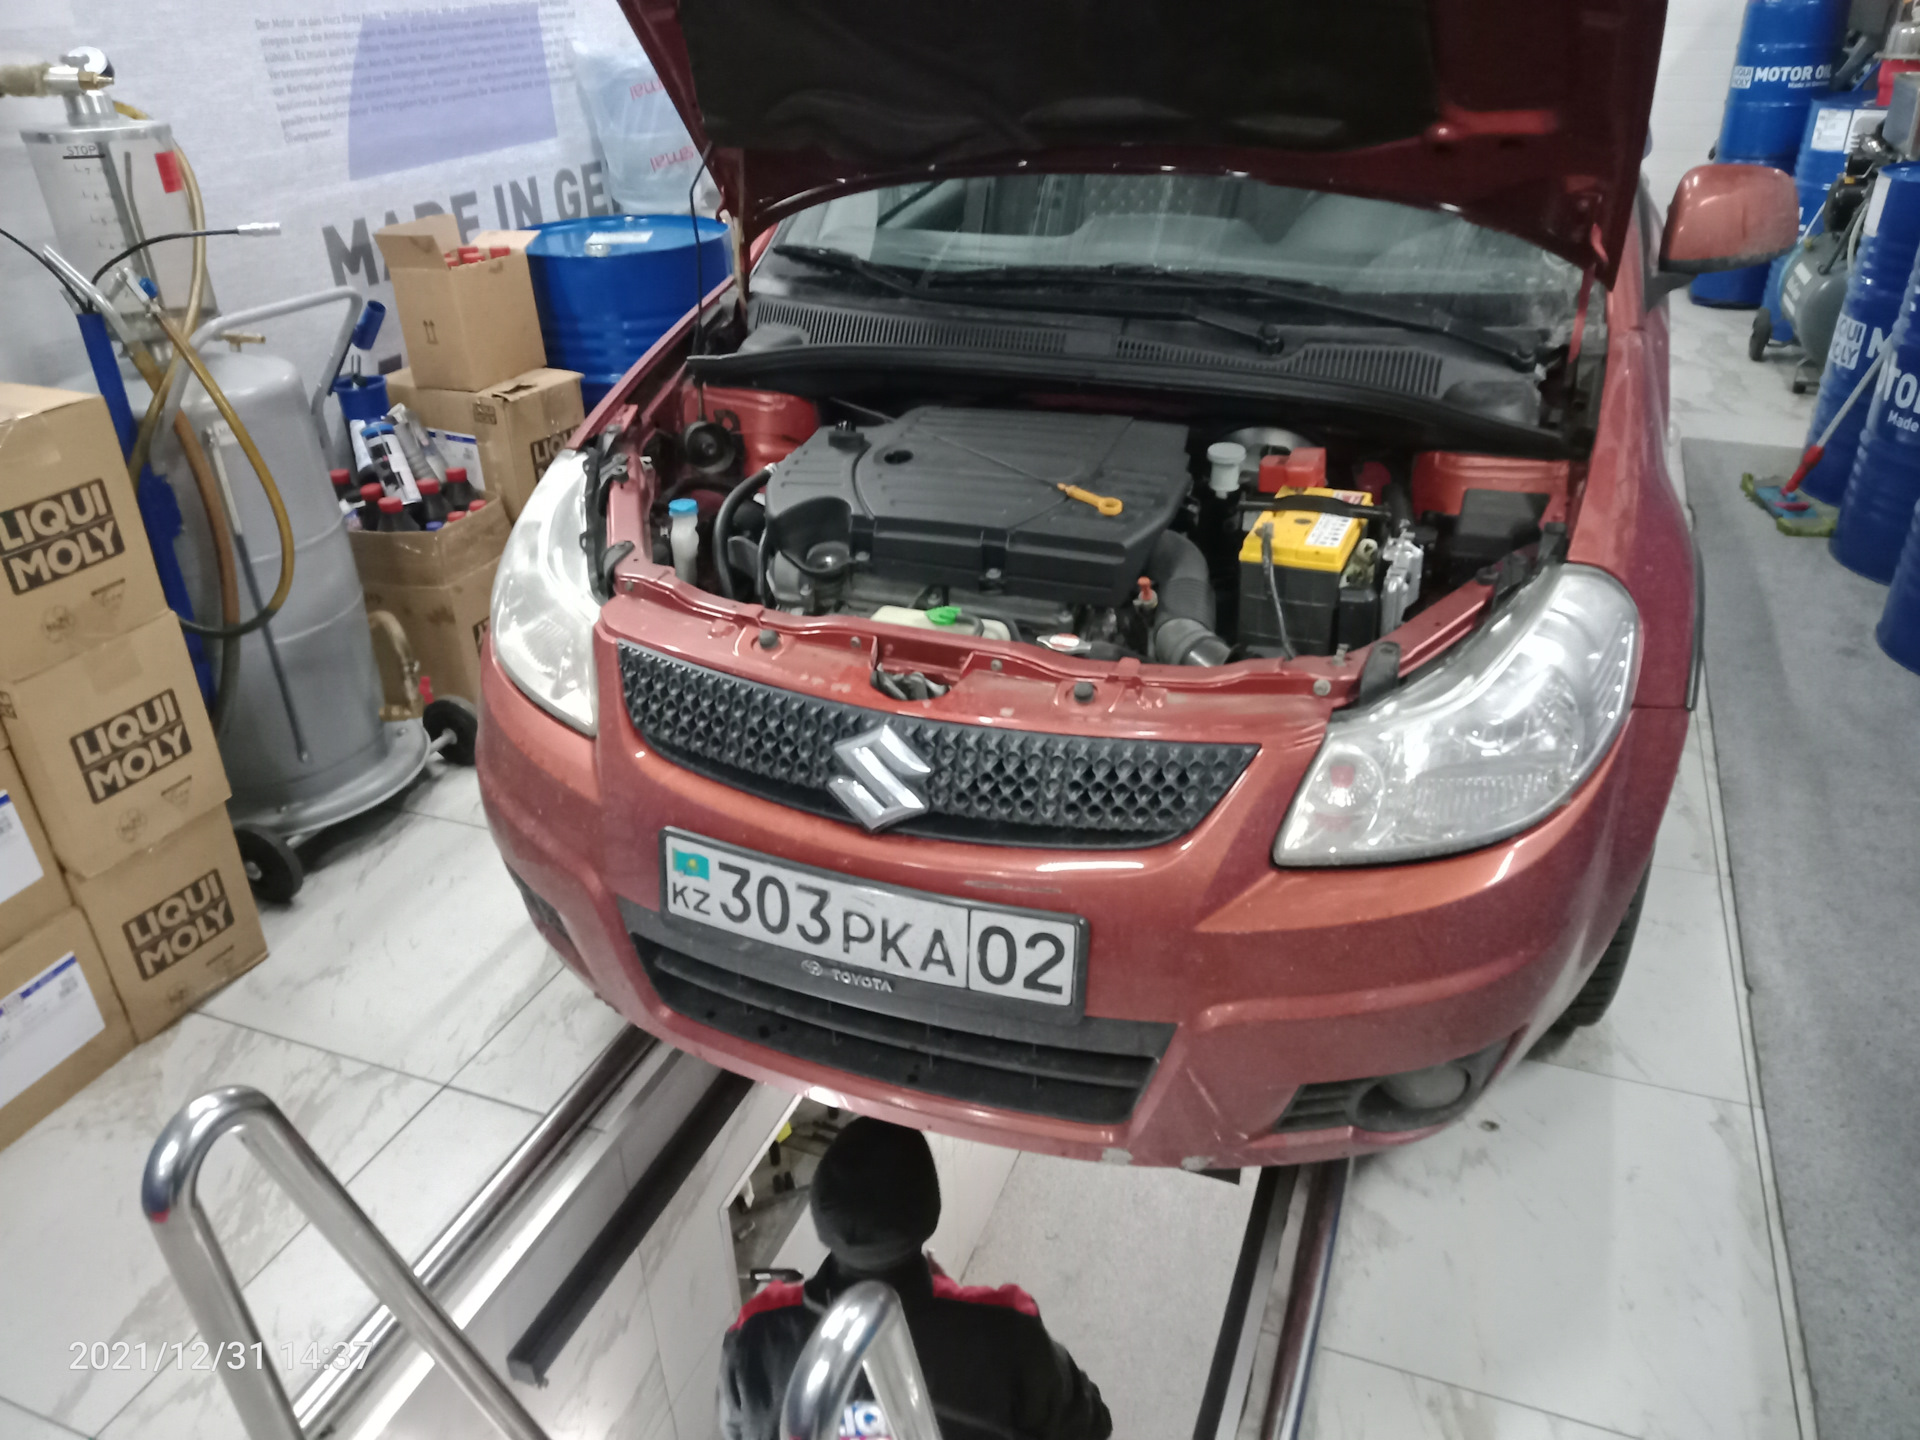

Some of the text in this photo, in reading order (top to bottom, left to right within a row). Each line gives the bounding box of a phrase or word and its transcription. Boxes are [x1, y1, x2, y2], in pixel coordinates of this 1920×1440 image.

[1754, 65, 1813, 82] MOTOR
[66, 144, 97, 156] STOP
[493, 175, 543, 230] IN
[554, 160, 611, 219] GE
[1888, 409, 1919, 433] Made
[0, 482, 108, 551] LIQUI
[11, 519, 116, 592] MOLY
[75, 692, 179, 766] LIQUI
[88, 723, 192, 801] MOLY
[128, 873, 221, 948] LIQUI
[140, 900, 228, 977] MOLY
[672, 861, 1066, 994] KZ 303 PKA 02
[831, 968, 893, 993] TOYOTA
